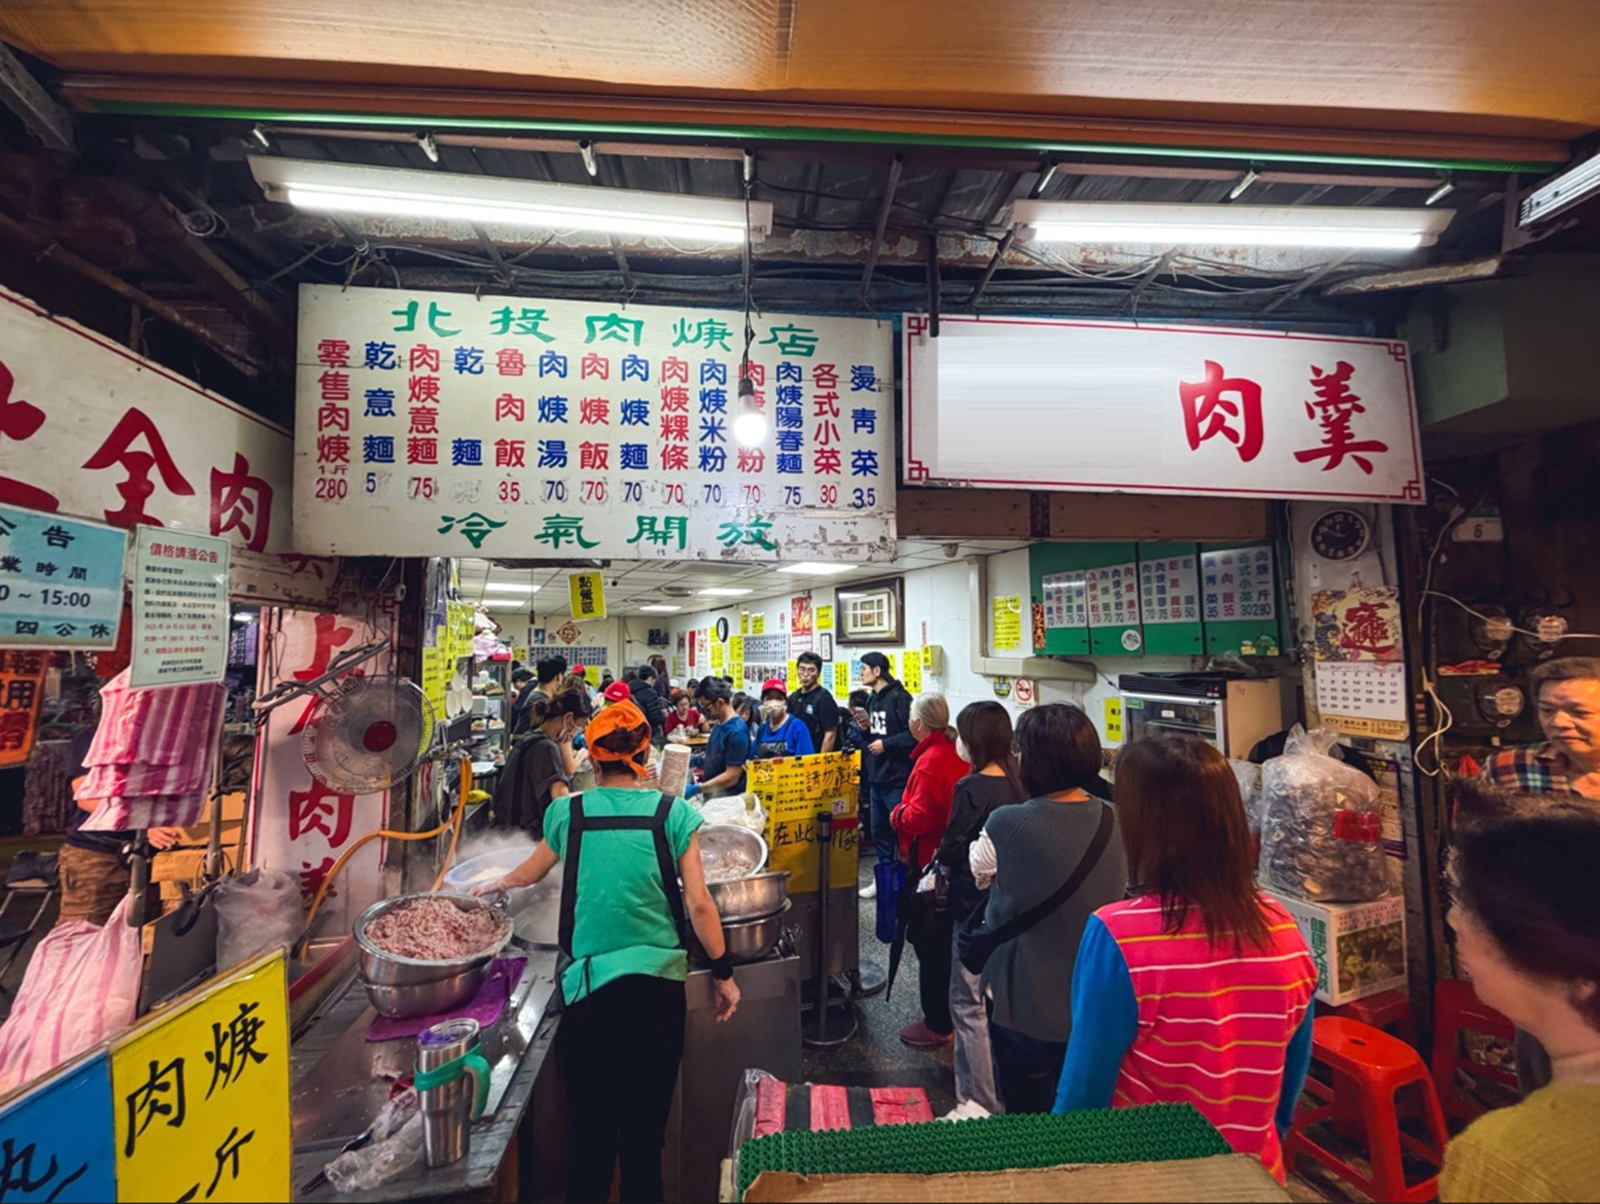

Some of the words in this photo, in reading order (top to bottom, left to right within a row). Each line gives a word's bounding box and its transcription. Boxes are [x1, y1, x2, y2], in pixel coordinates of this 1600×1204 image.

[316, 339, 351, 464] 零售肉焿
[363, 341, 396, 464] 乾意麵
[407, 343, 440, 466] 肉焿意麵
[494, 347, 526, 468] 魯肉飯
[537, 350, 568, 469] 肉焿湯
[579, 352, 611, 470] 肉焿飯
[620, 354, 650, 471] 肉焿麵
[698, 358, 728, 473] 肉焿米粉
[775, 361, 804, 474] 肉焿陽春麵
[812, 363, 842, 475] 各式小菜
[850, 365, 879, 477] 燙青菜
[1179, 359, 1389, 475] 肉羹
[315, 478, 347, 499] 280
[412, 477, 433, 499] 75
[499, 480, 520, 502] 35
[546, 480, 565, 501] 70
[586, 481, 605, 501] 70
[624, 482, 643, 502] 70
[665, 484, 684, 503] 70
[704, 484, 722, 503] 70
[743, 484, 761, 504] 70
[784, 485, 801, 505] 75
[819, 484, 837, 505] 30
[437, 511, 778, 550] 冷氣開放
[1474, 524, 1483, 538] 6
[41, 588, 91, 608] 15:00
[1207, 606, 1218, 618] 35
[1223, 605, 1235, 617] 35
[1241, 604, 1252, 616] 30
[1253, 603, 1271, 616] 280
